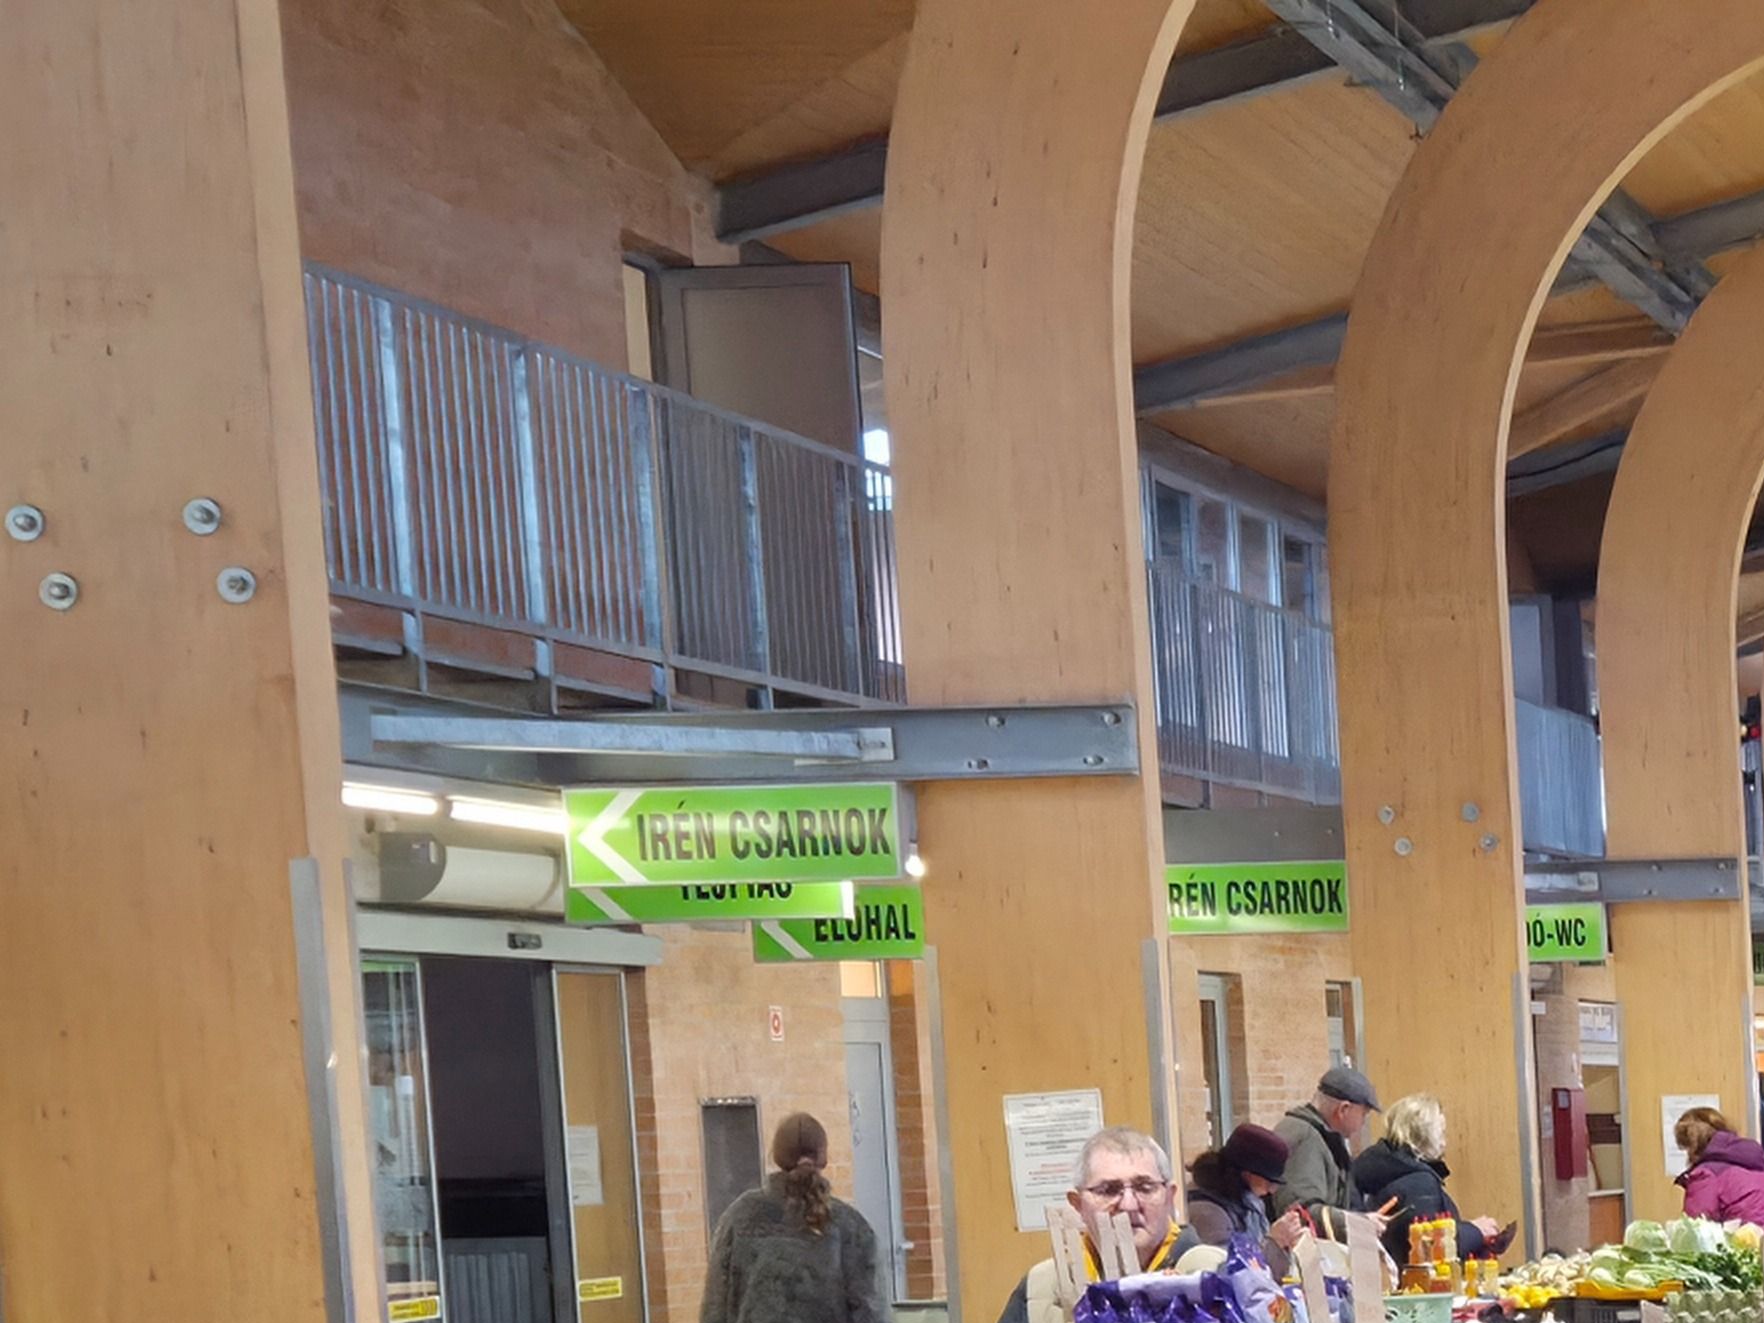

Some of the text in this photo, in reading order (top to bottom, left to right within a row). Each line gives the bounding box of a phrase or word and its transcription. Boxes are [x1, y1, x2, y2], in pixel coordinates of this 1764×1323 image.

[637, 801, 892, 861] IRÉN CSARNOK
[1168, 872, 1344, 917] RÉN CSARNOK
